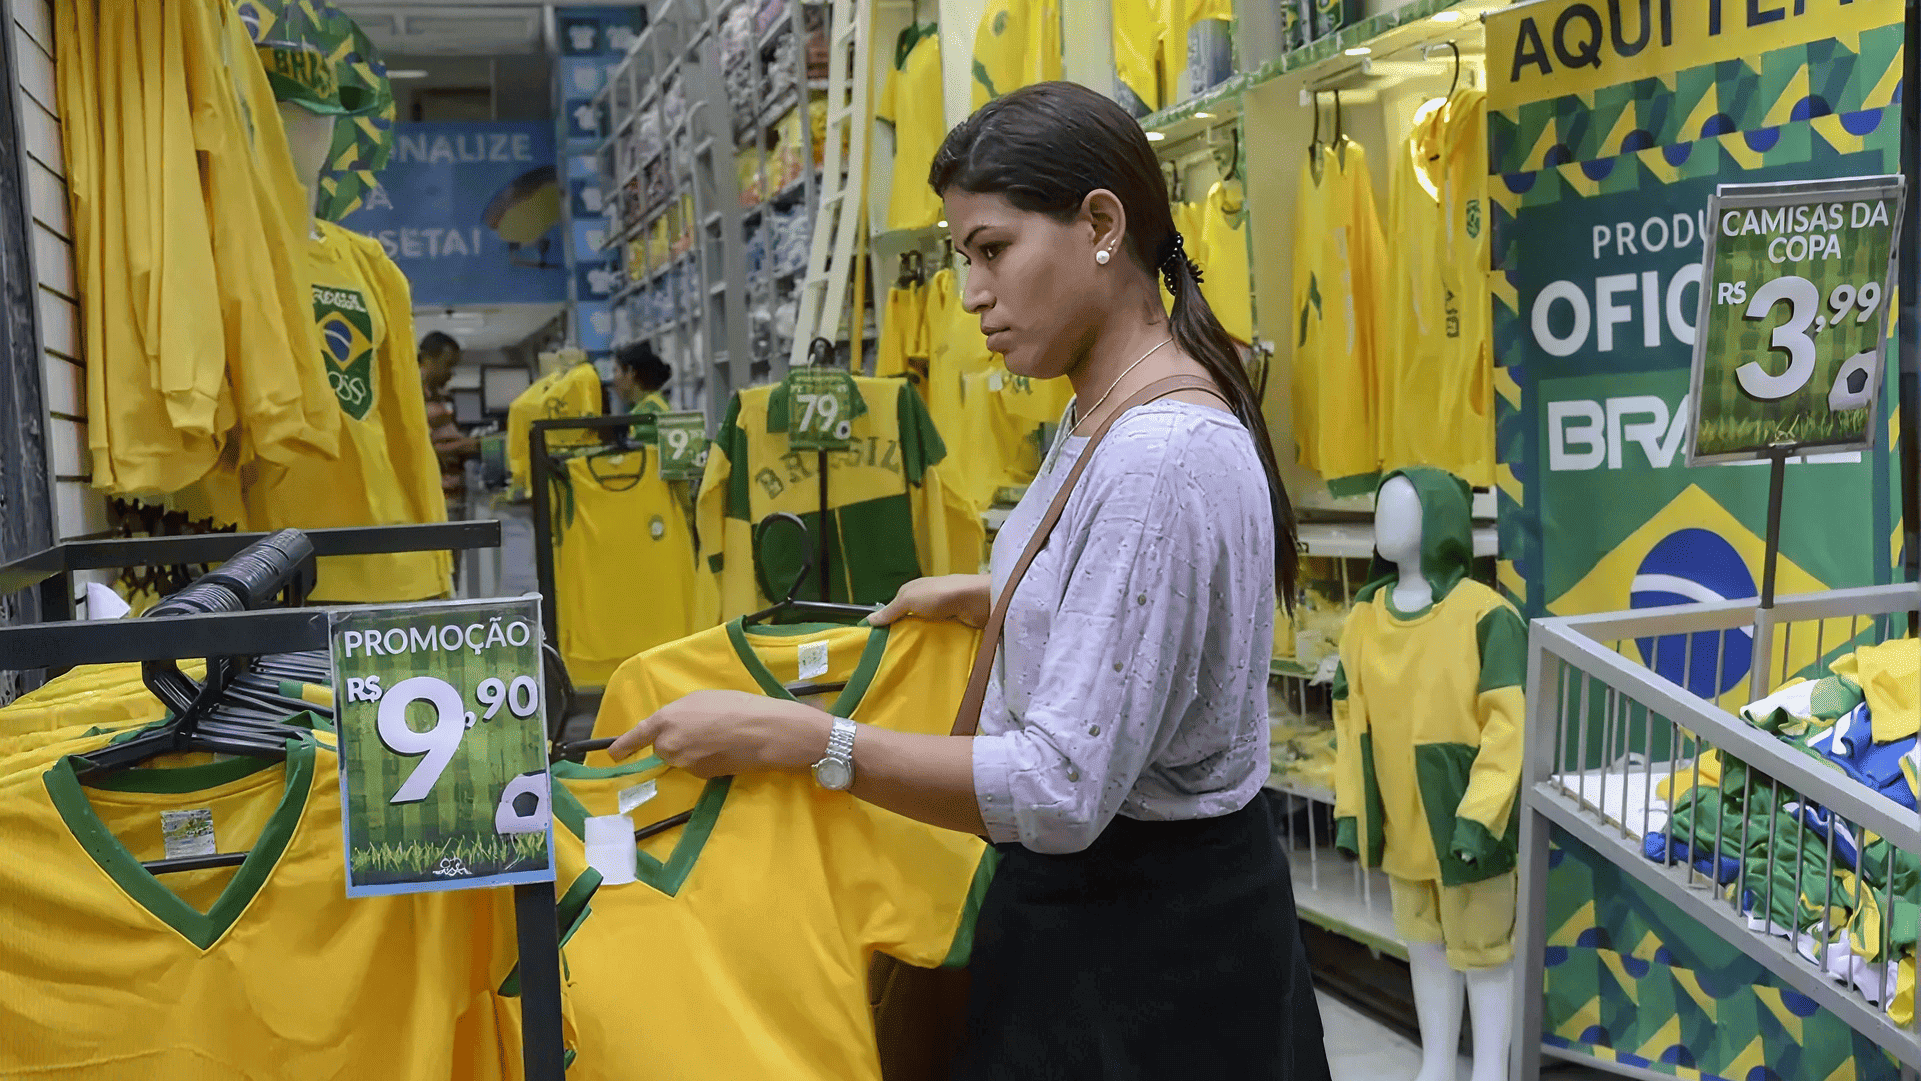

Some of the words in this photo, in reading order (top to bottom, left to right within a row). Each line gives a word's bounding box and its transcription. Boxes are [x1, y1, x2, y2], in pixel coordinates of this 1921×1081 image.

[1510, 0, 1672, 83] AQUI
[391, 133, 533, 164] NALIZE
[1722, 203, 1844, 237] CAMISAS
[1850, 200, 1889, 229] DA
[368, 226, 483, 259] SETA!
[1768, 233, 1842, 264] COPA
[344, 617, 530, 658] PROMOÇÃO
